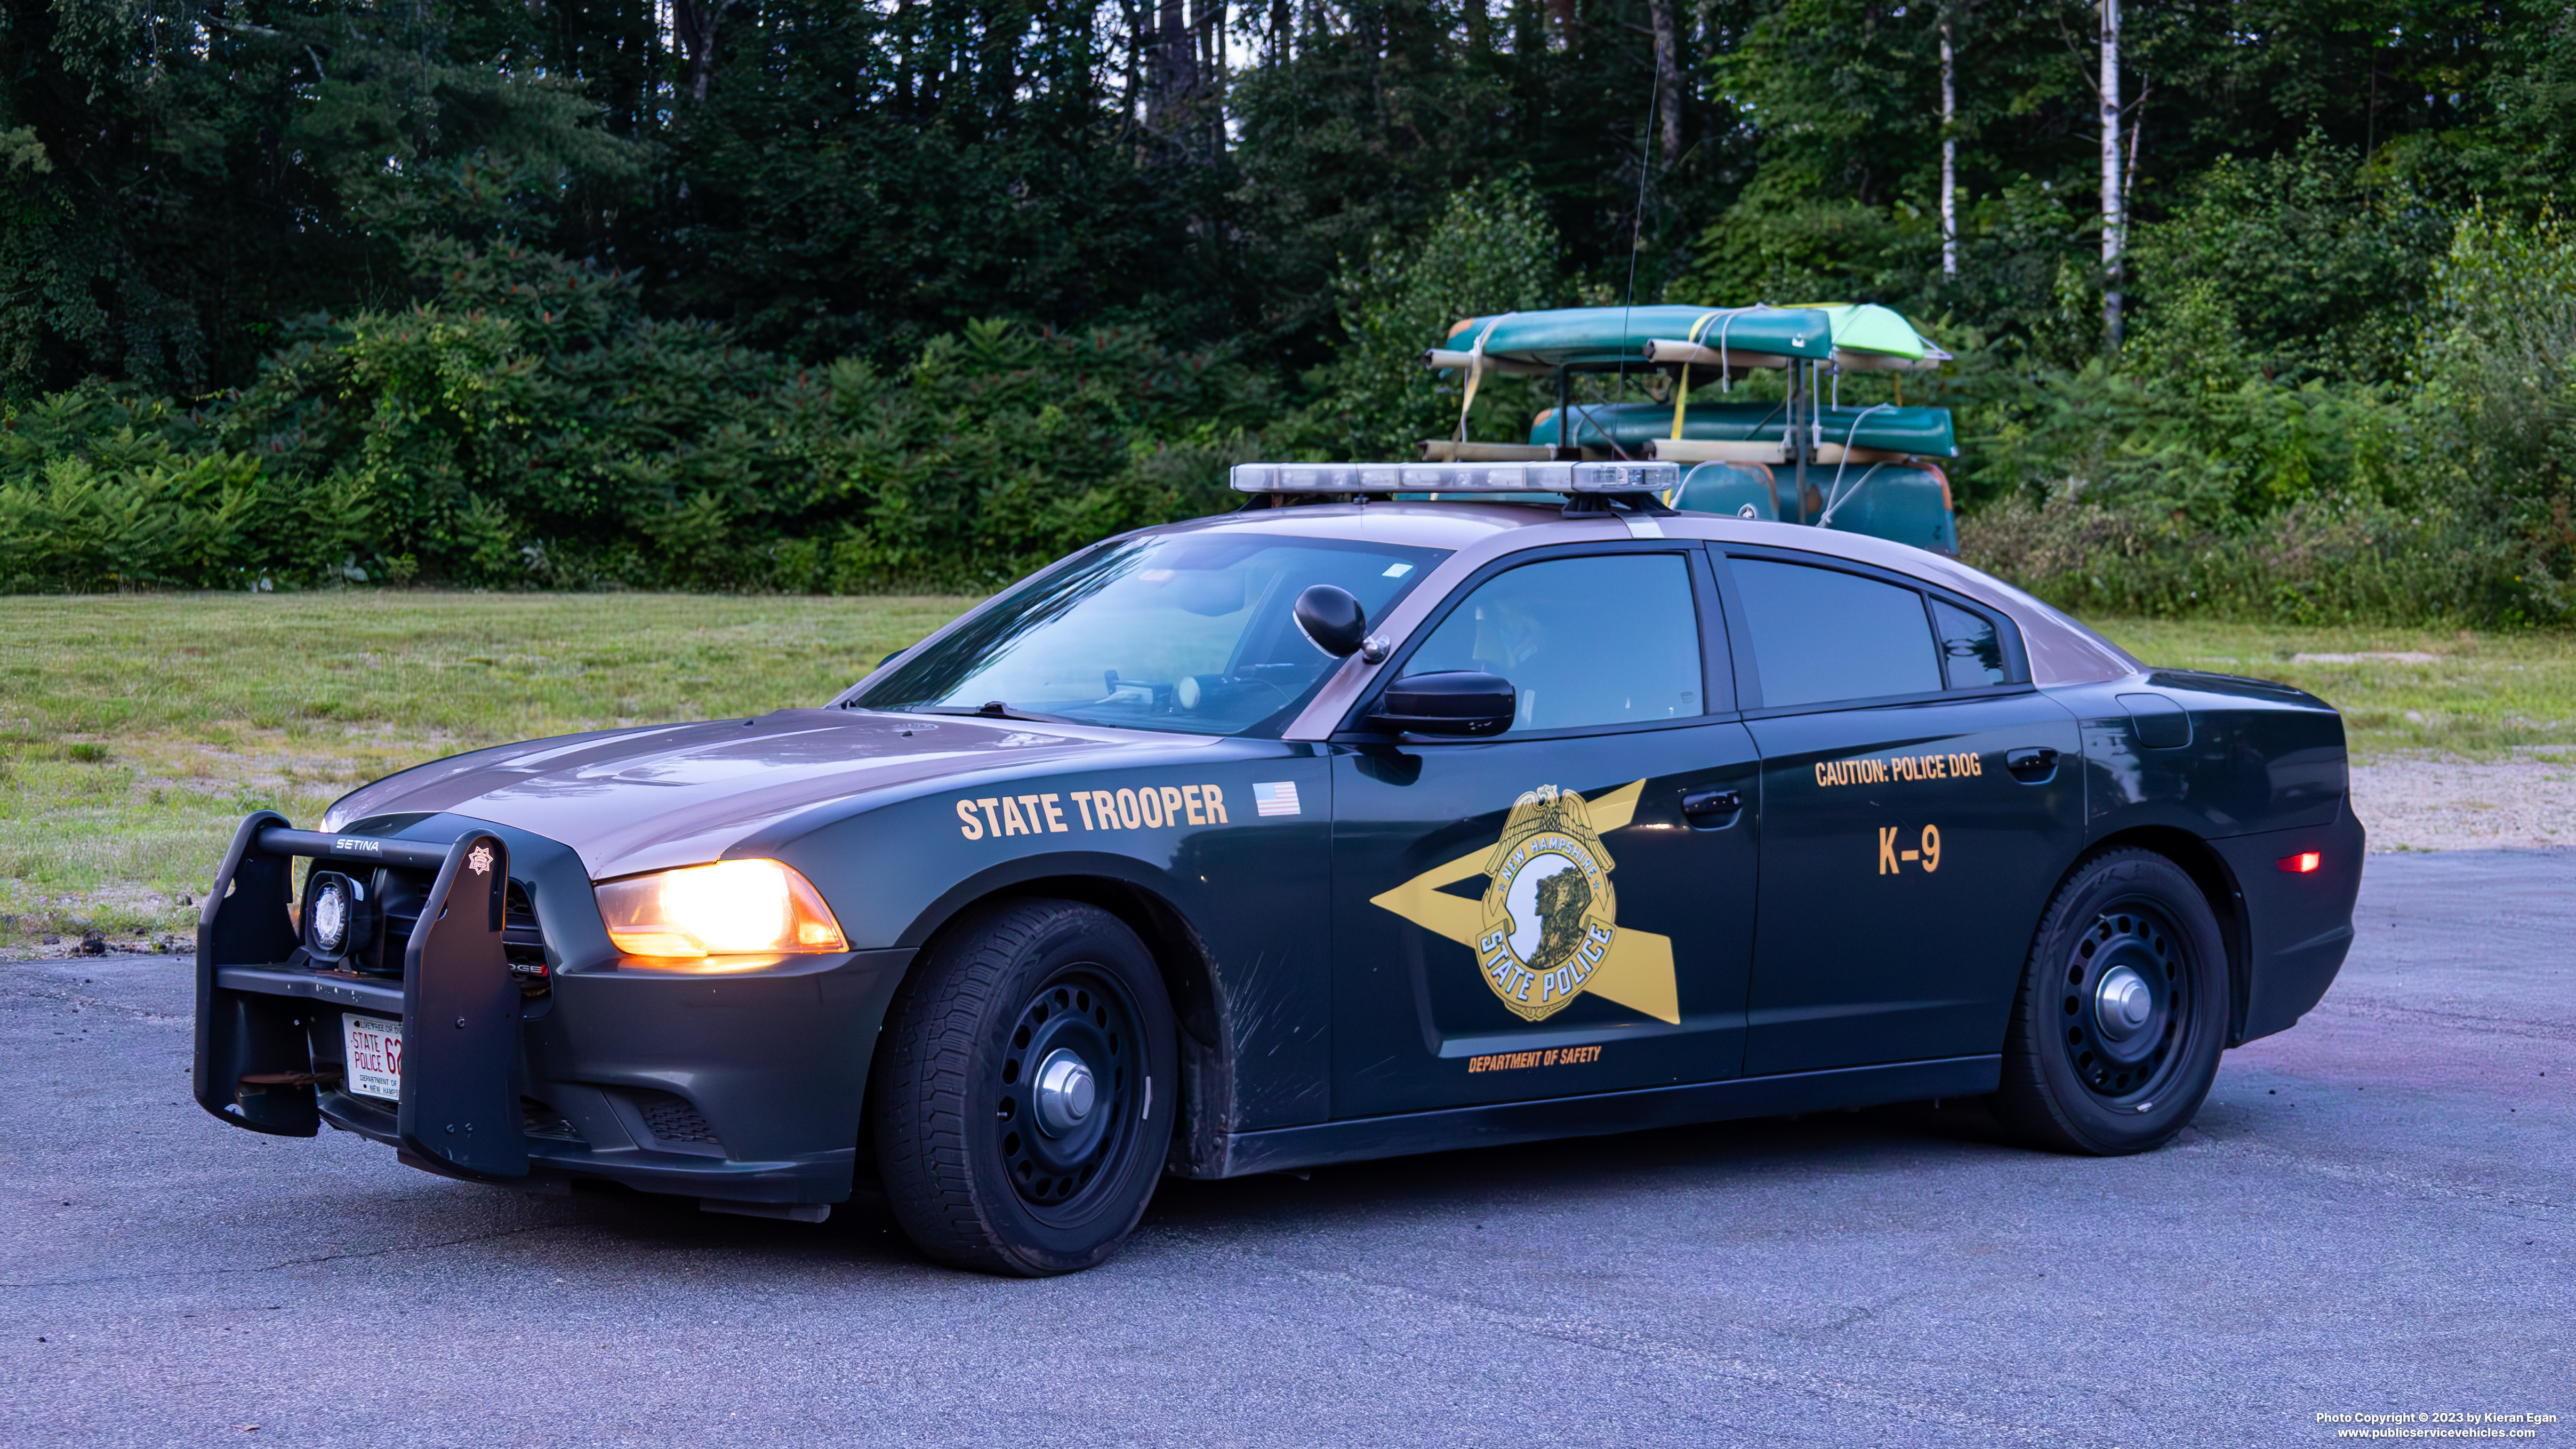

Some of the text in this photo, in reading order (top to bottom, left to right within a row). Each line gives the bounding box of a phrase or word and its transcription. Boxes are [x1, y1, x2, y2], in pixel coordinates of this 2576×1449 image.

[1815, 752, 1981, 787] CAUTION: POLICE DOG
[956, 784, 1229, 840] STATE TROOPER
[336, 839, 379, 852] SETINA
[1502, 836, 1597, 881] NEW HAMPSHIRE
[1879, 824, 1941, 875] K-9
[1481, 923, 1612, 1002] STATE POLICE
[353, 1031, 380, 1052] STATE
[355, 1051, 383, 1072] POLICE
[1468, 1046, 1602, 1072] DEPARTMENT OF SAFETY
[360, 1075, 388, 1085] DEPARTMENT
